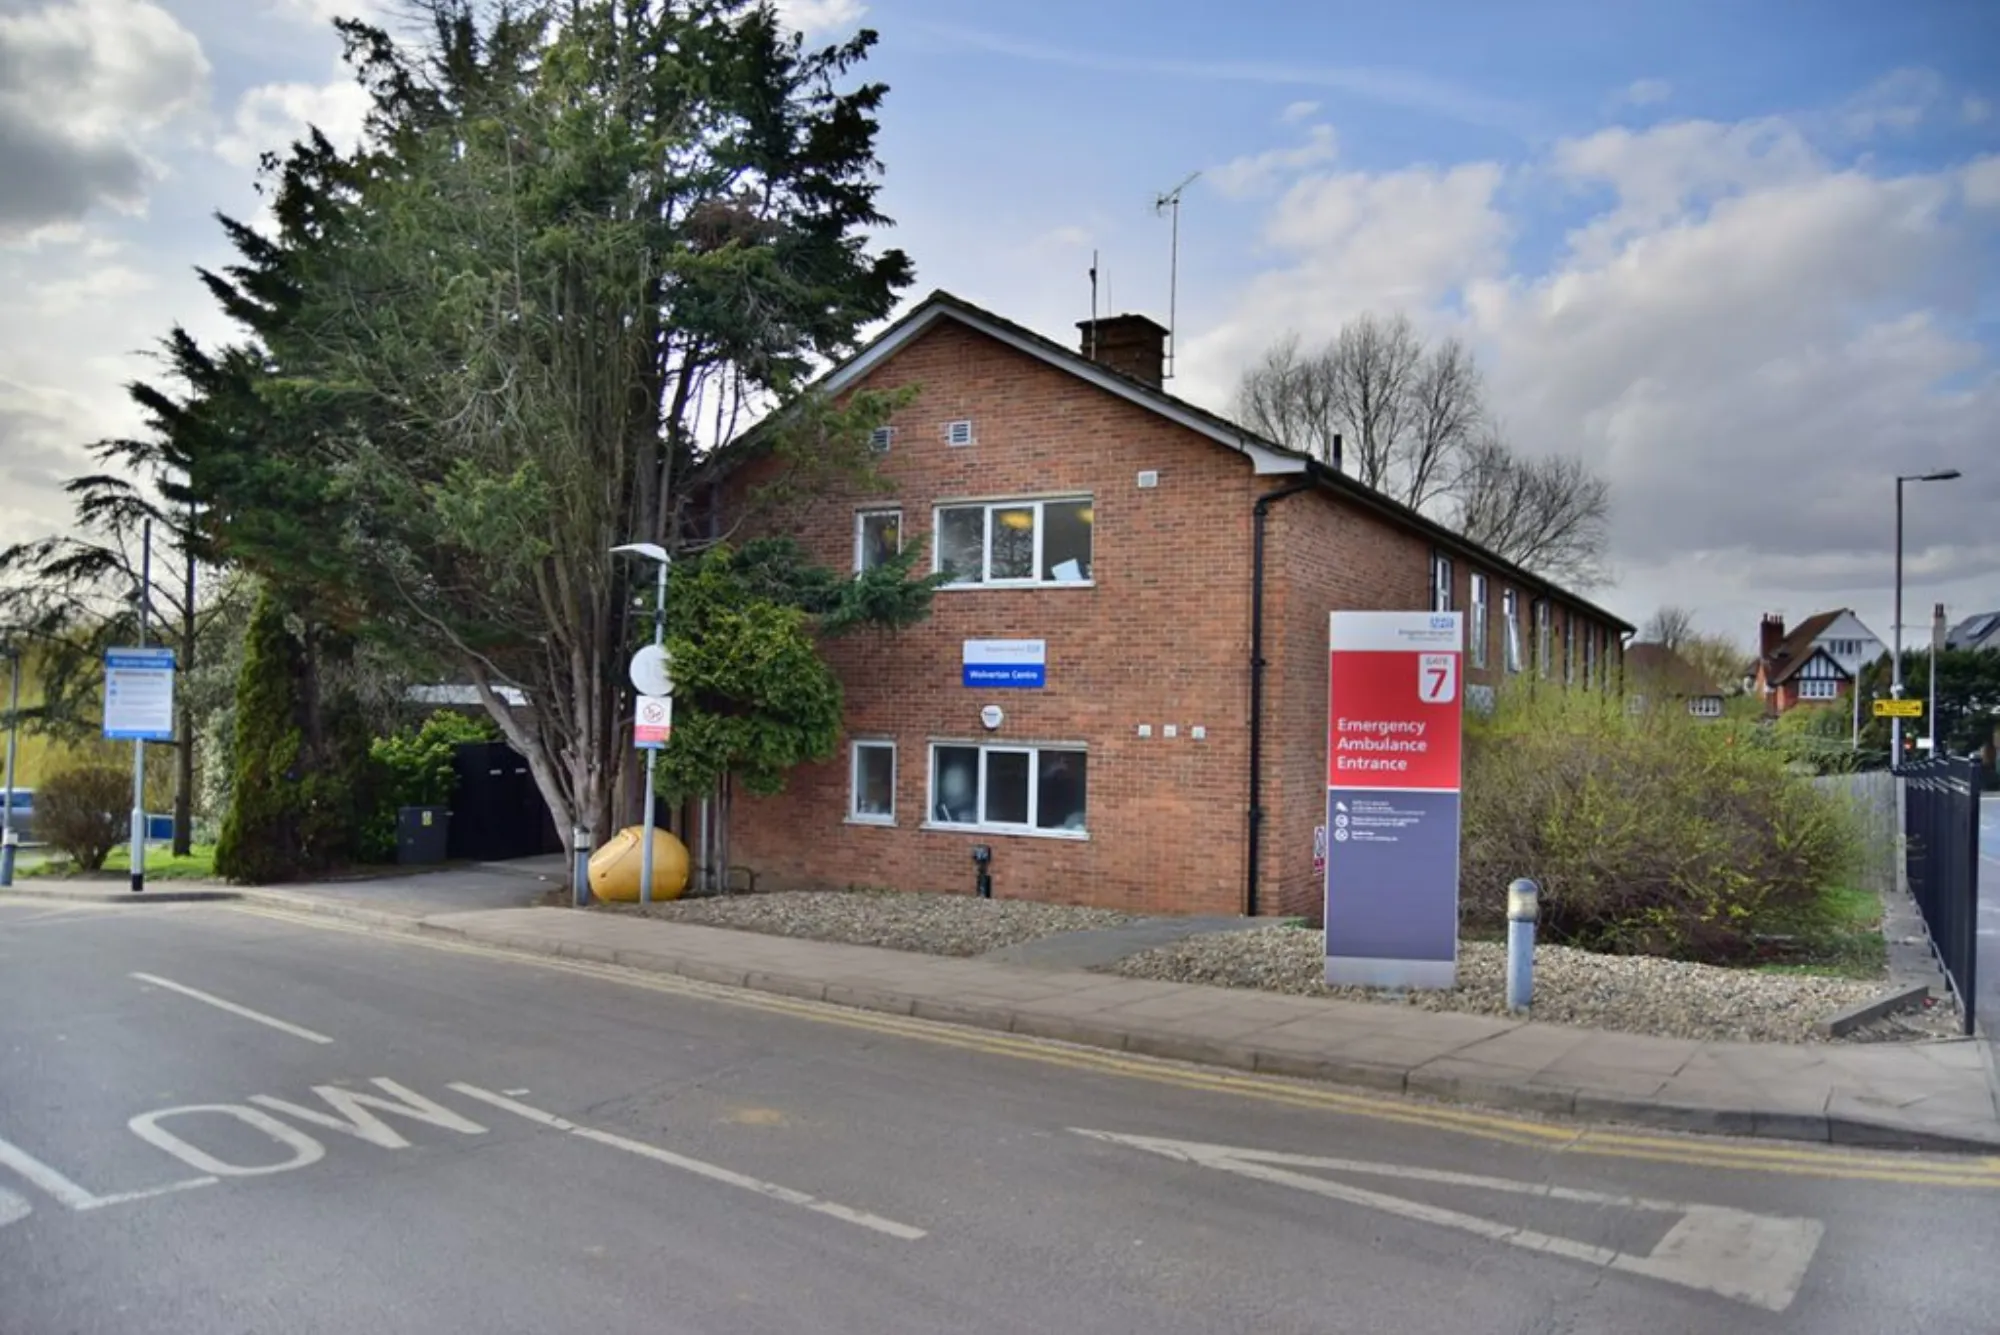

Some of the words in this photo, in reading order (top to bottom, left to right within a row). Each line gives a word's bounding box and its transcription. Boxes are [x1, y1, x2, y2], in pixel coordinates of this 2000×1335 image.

[1011, 670, 1038, 680] Centre
[1427, 668, 1447, 698] 7
[1337, 717, 1426, 736] Emergency
[1337, 736, 1427, 752] Ambulance
[1337, 755, 1407, 771] Entrance
